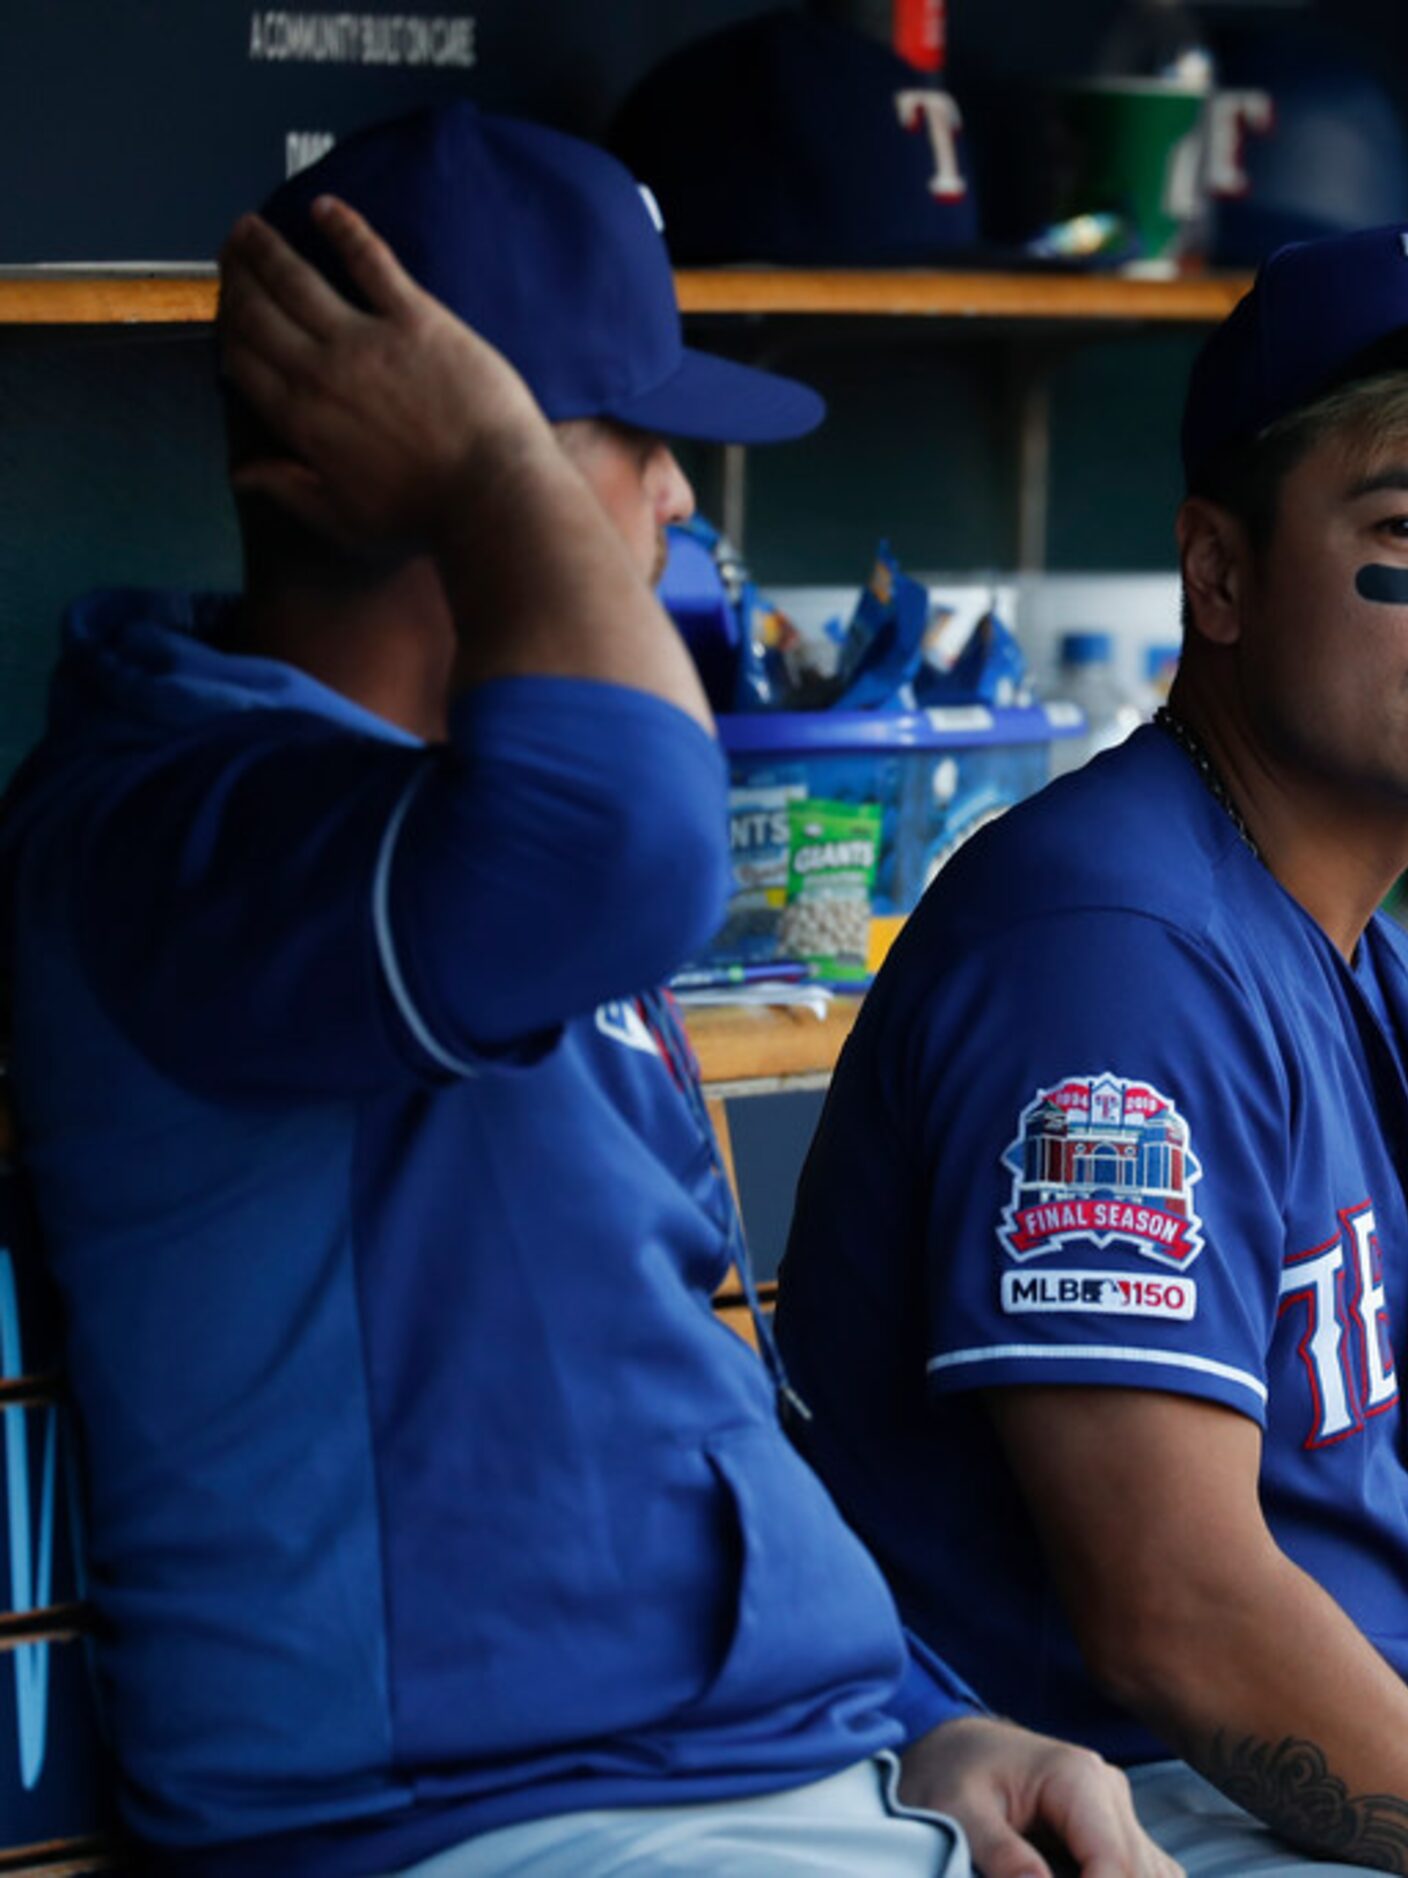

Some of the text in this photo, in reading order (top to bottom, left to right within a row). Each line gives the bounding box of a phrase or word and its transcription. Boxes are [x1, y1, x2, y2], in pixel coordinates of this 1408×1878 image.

[250, 12, 262, 60] A
[896, 89, 965, 203] T
[731, 813, 790, 848] NTS
[794, 840, 874, 874] GIANTS
[1025, 1204, 1180, 1243] FINAL SEASON
[1012, 1278, 1186, 1310] MLB 150
